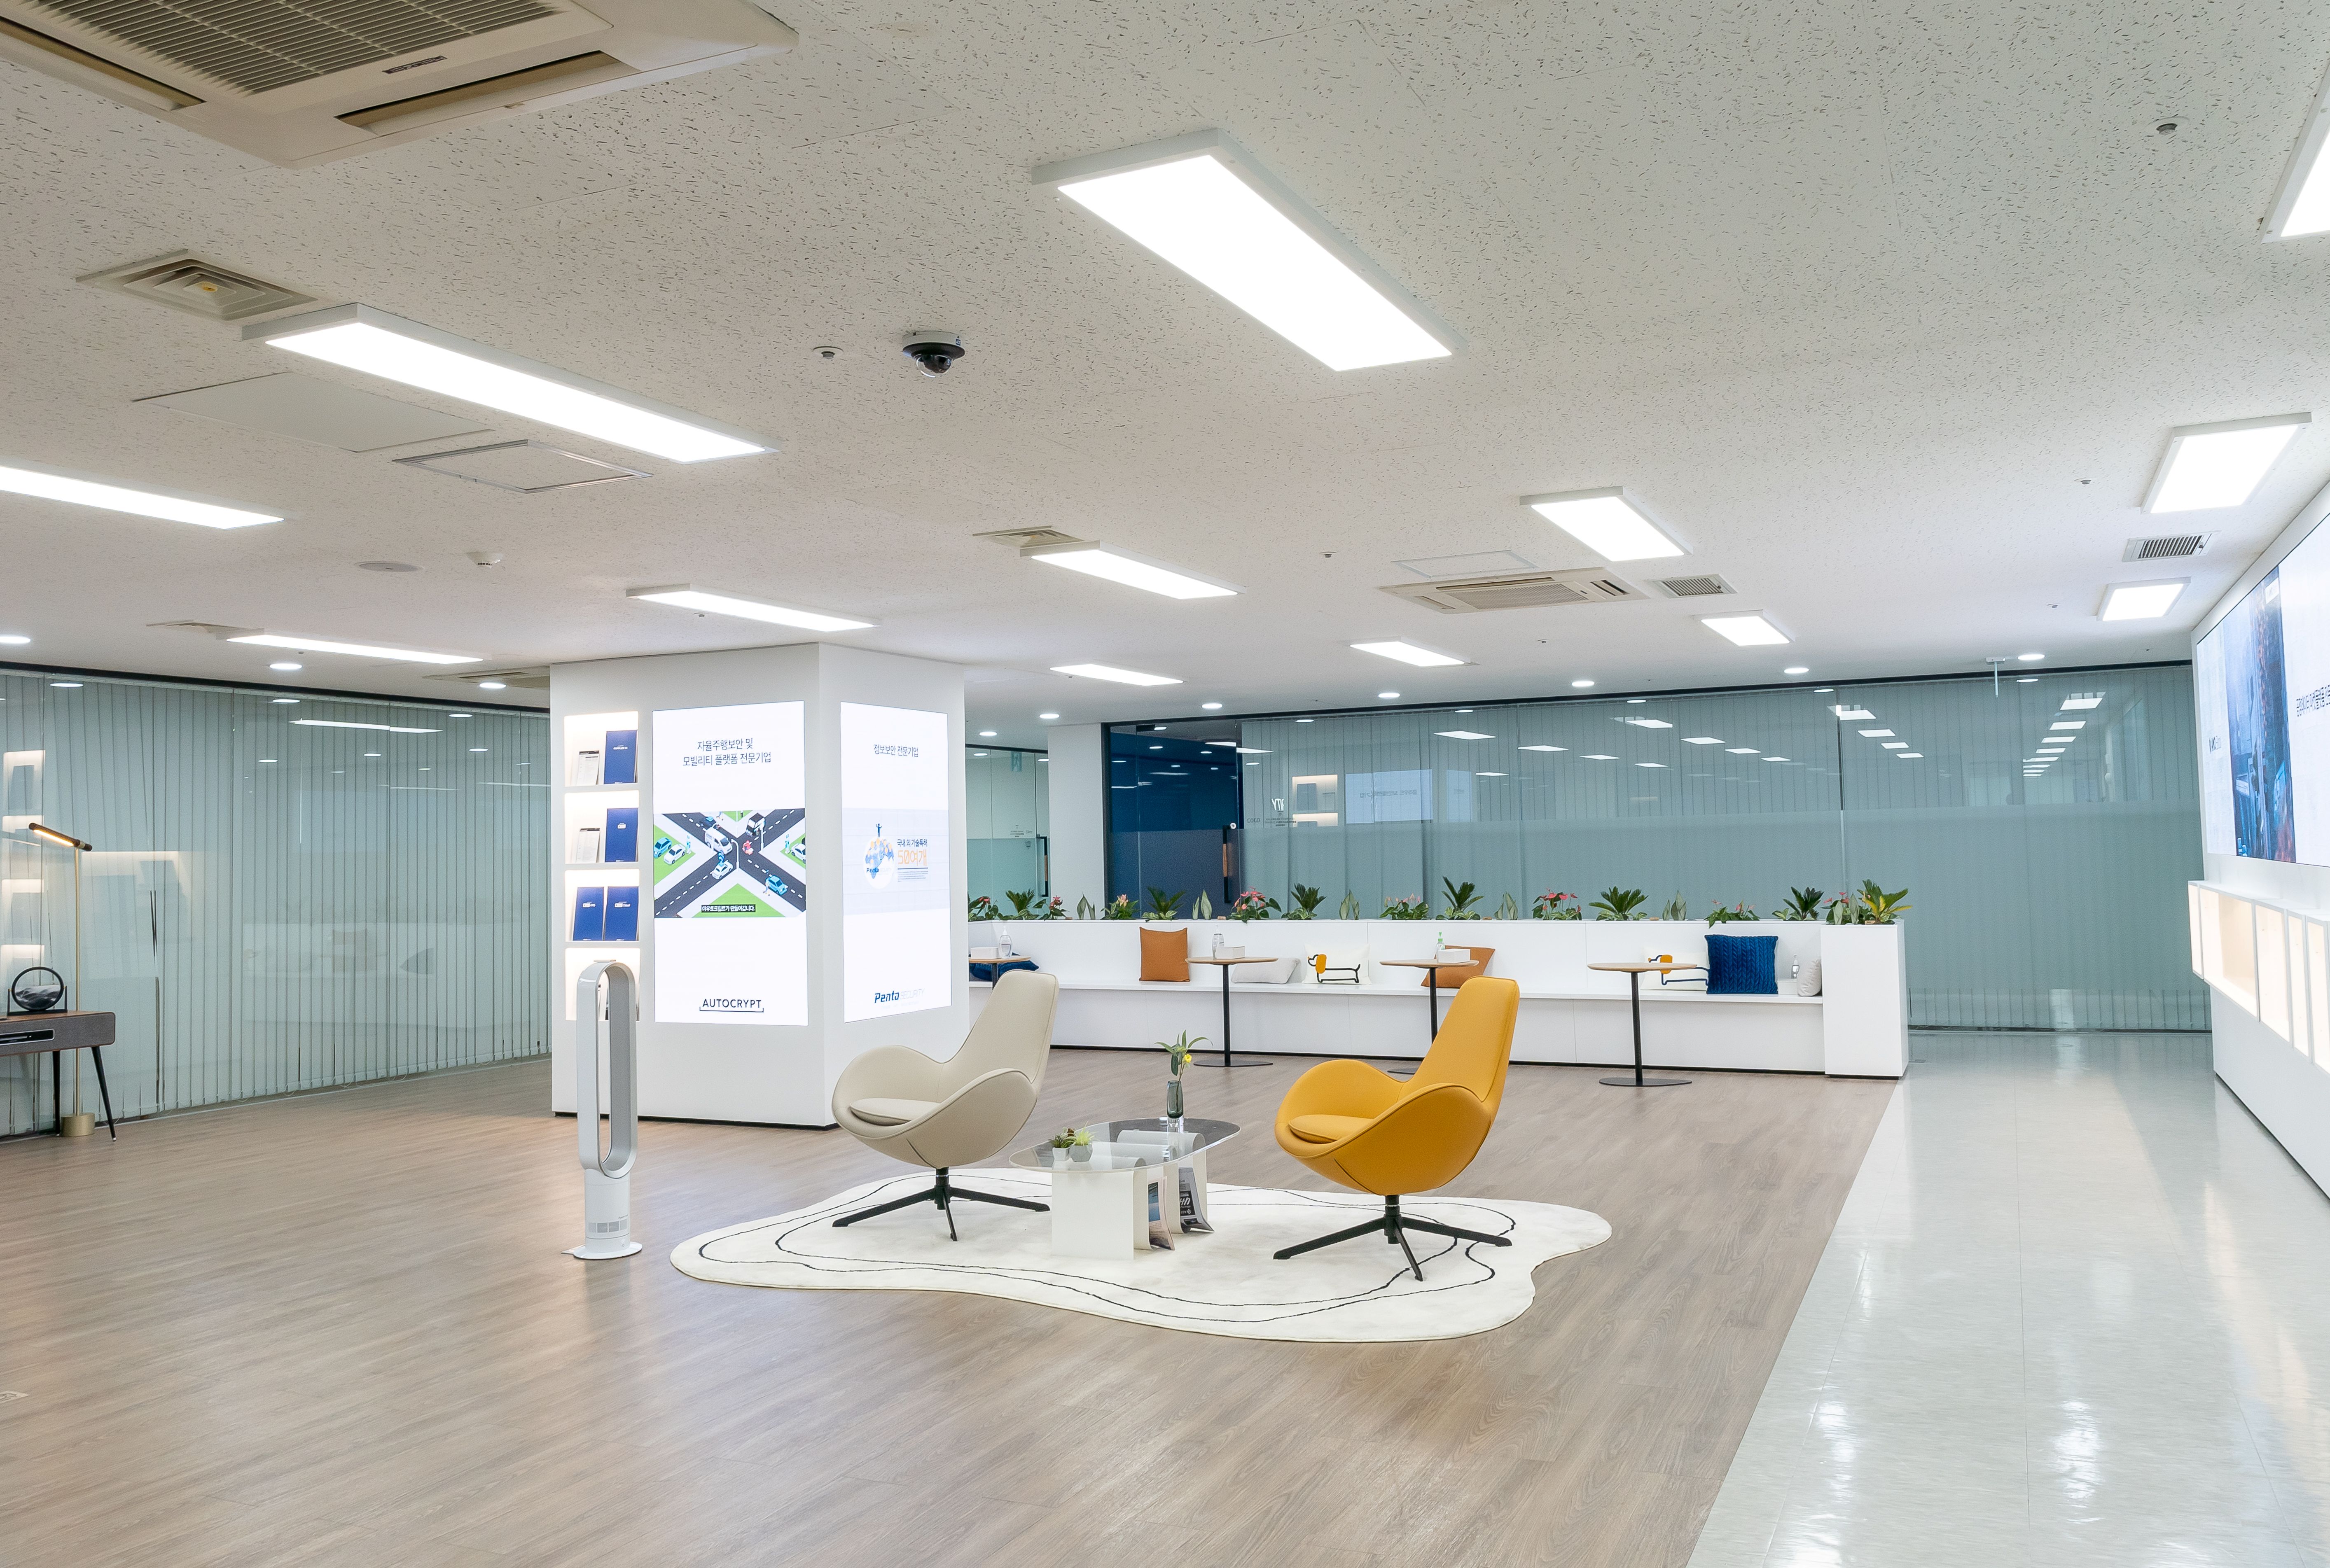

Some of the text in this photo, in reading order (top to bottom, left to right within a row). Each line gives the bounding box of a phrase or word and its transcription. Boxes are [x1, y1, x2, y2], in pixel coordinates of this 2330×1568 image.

[697, 738, 753, 751] 자율주행보안 및
[874, 744, 918, 757] 정보보안 전문기업
[683, 751, 771, 767] 모빌리티 플랫폼 전문기업
[898, 849, 927, 866] 50여개
[874, 990, 900, 1003] Penta
[702, 999, 762, 1008] AUTOCRYPT
